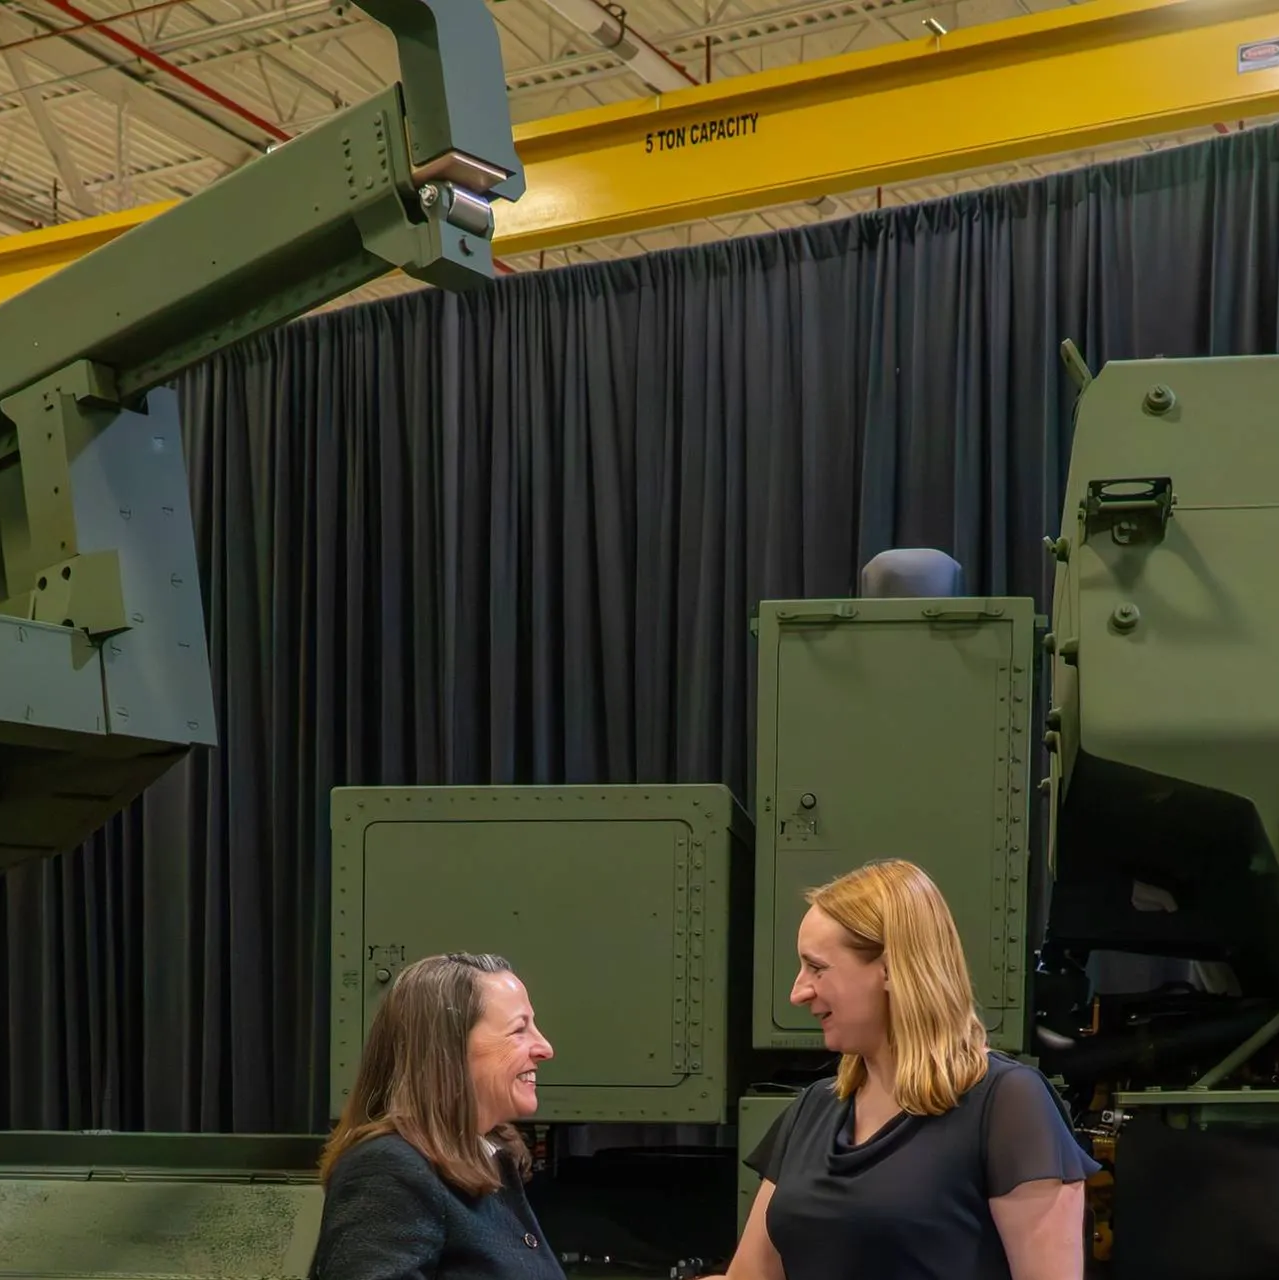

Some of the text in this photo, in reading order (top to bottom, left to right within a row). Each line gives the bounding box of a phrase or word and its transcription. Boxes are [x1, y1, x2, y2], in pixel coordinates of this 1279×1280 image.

[645, 112, 759, 154] 5 TON CAPACITY
